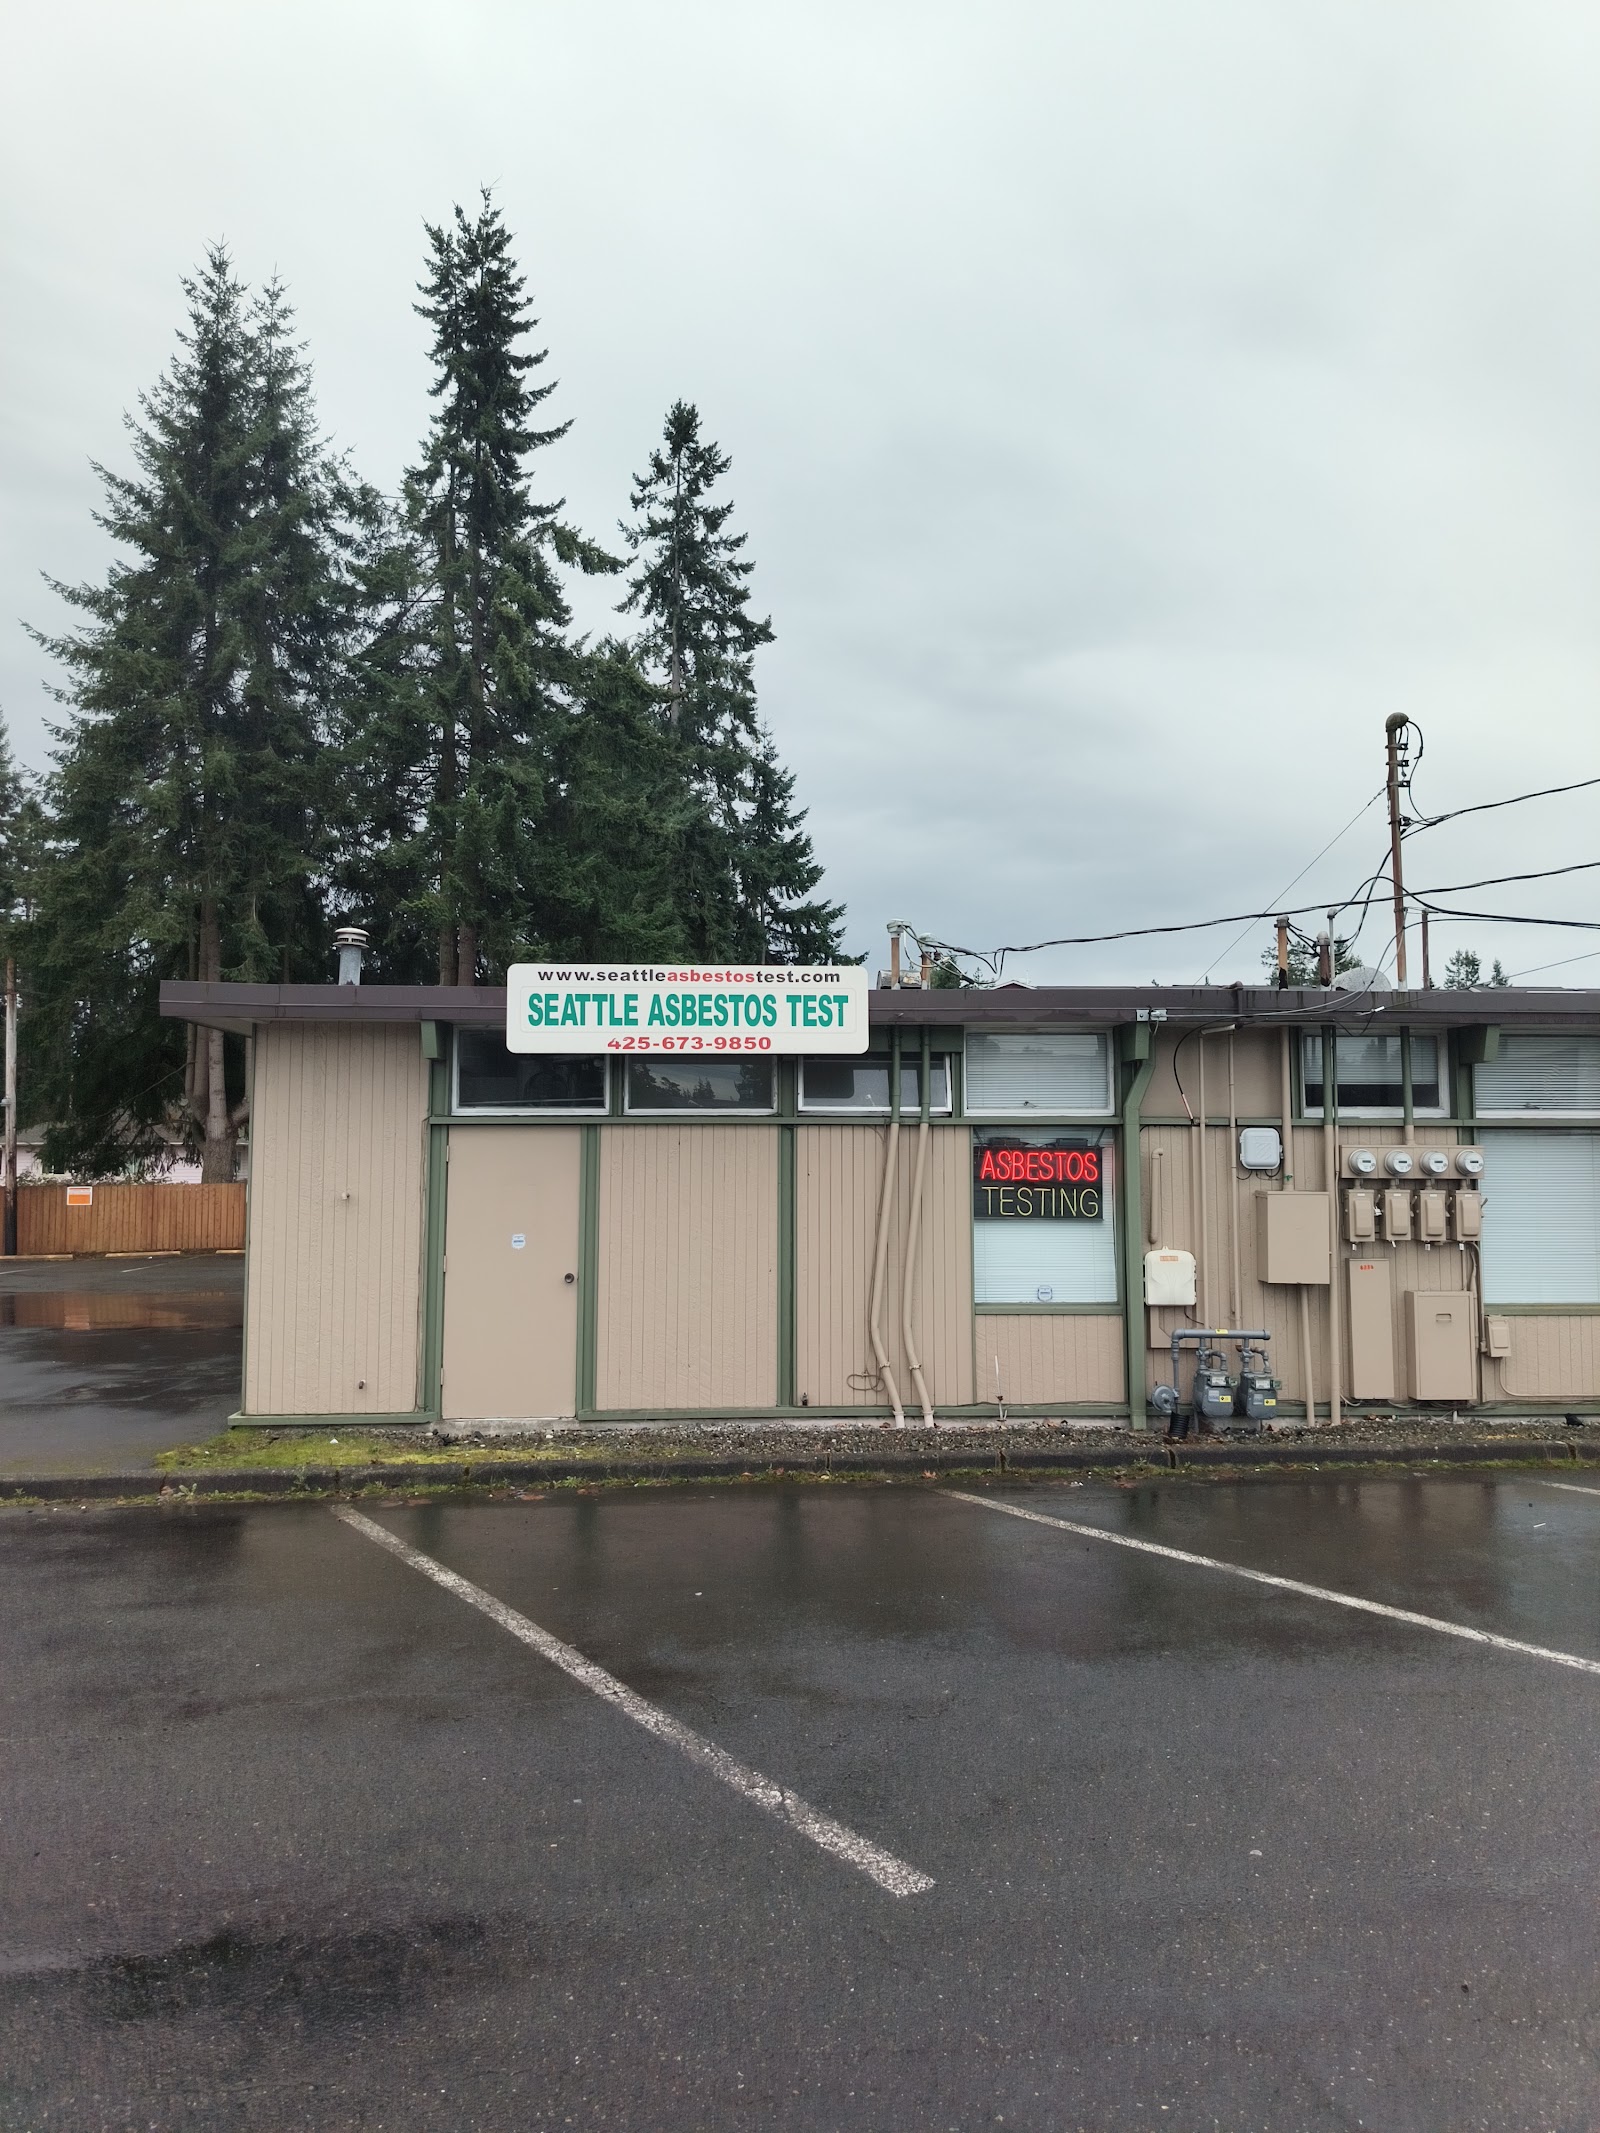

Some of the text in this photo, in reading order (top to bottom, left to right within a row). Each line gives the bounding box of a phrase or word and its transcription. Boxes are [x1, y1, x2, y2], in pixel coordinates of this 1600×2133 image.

[538, 969, 840, 983] www.seattleasbestostest.com
[528, 993, 849, 1028] SEATTLE ASBESTOS TEST
[607, 1036, 771, 1050] 425-673-9850
[980, 1150, 1098, 1181] ASBESTOS
[981, 1186, 1099, 1217] TESTING
